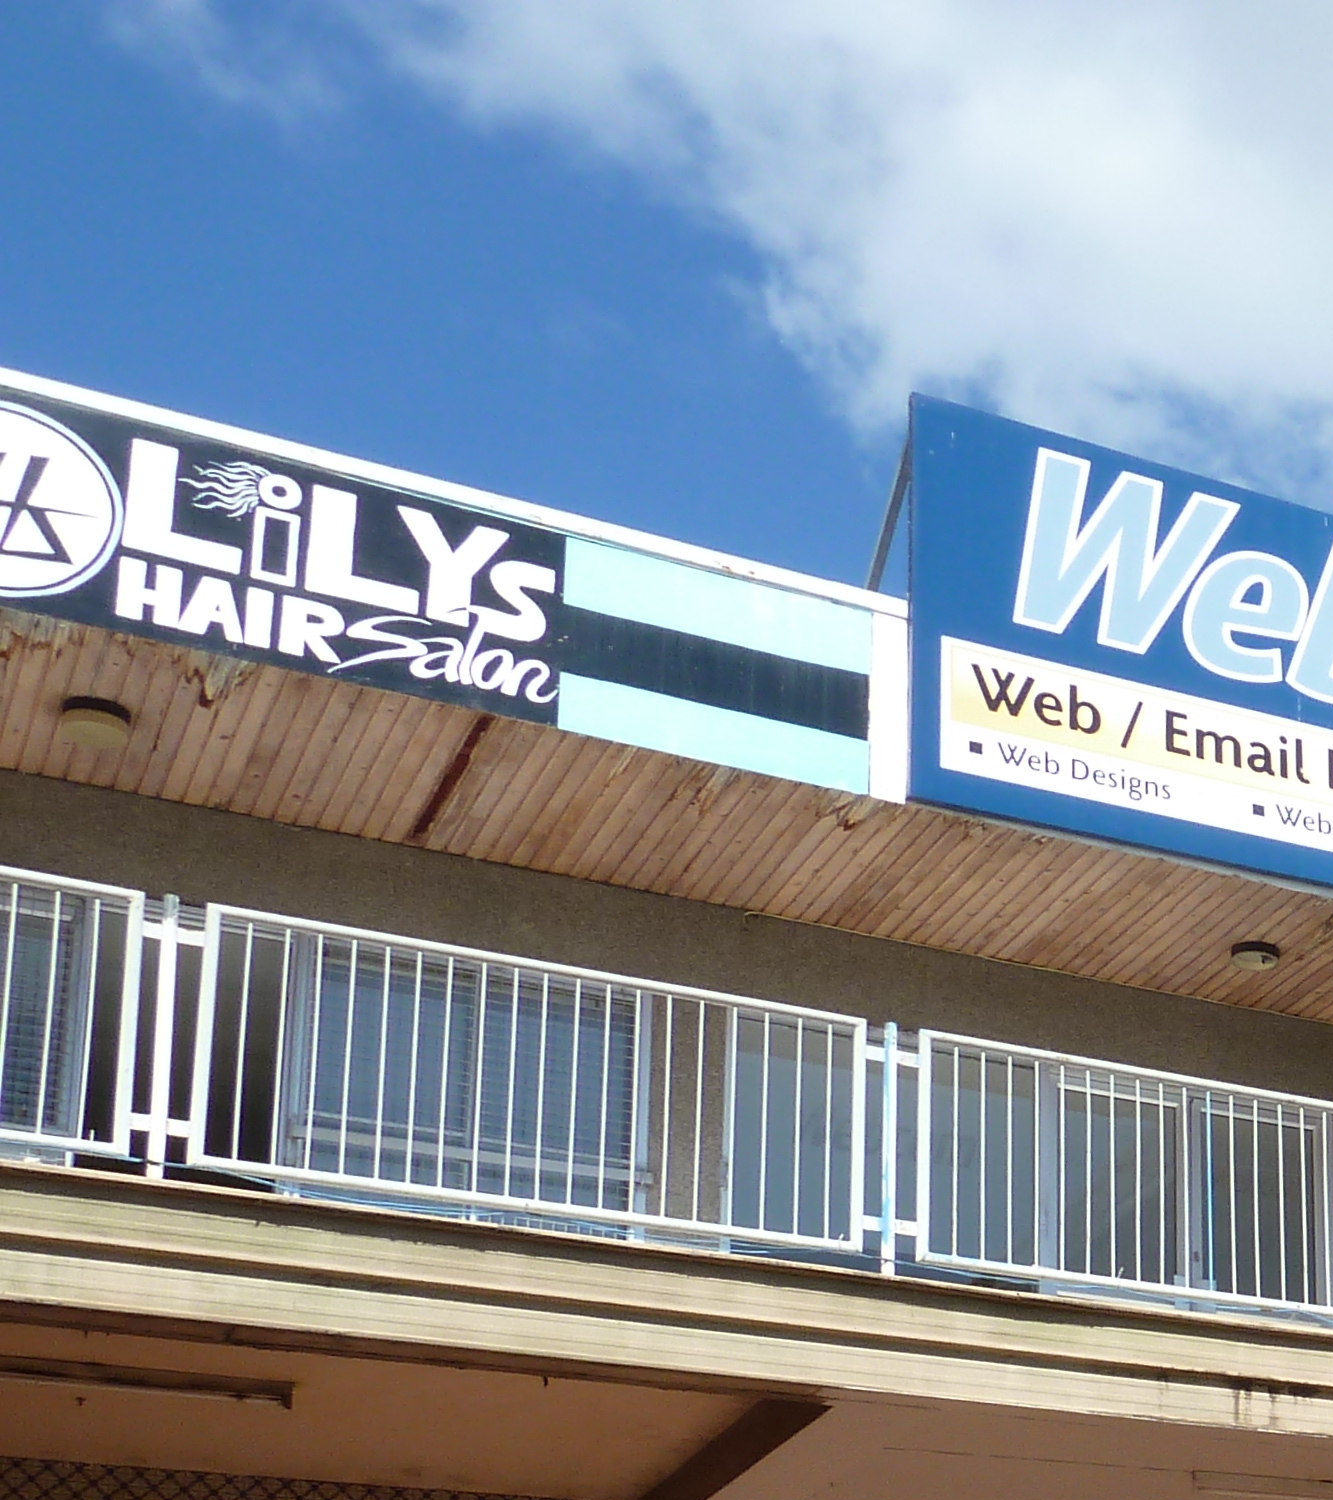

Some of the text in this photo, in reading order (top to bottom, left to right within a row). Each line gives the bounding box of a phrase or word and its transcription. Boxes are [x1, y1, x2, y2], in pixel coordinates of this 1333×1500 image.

[114, 557, 561, 704] HAIR Salon
[971, 663, 1101, 734] Web
[1121, 701, 1143, 748] /
[1165, 709, 1310, 784] Email
[998, 741, 1171, 801] Web Designs
[1275, 804, 1332, 835] Web
